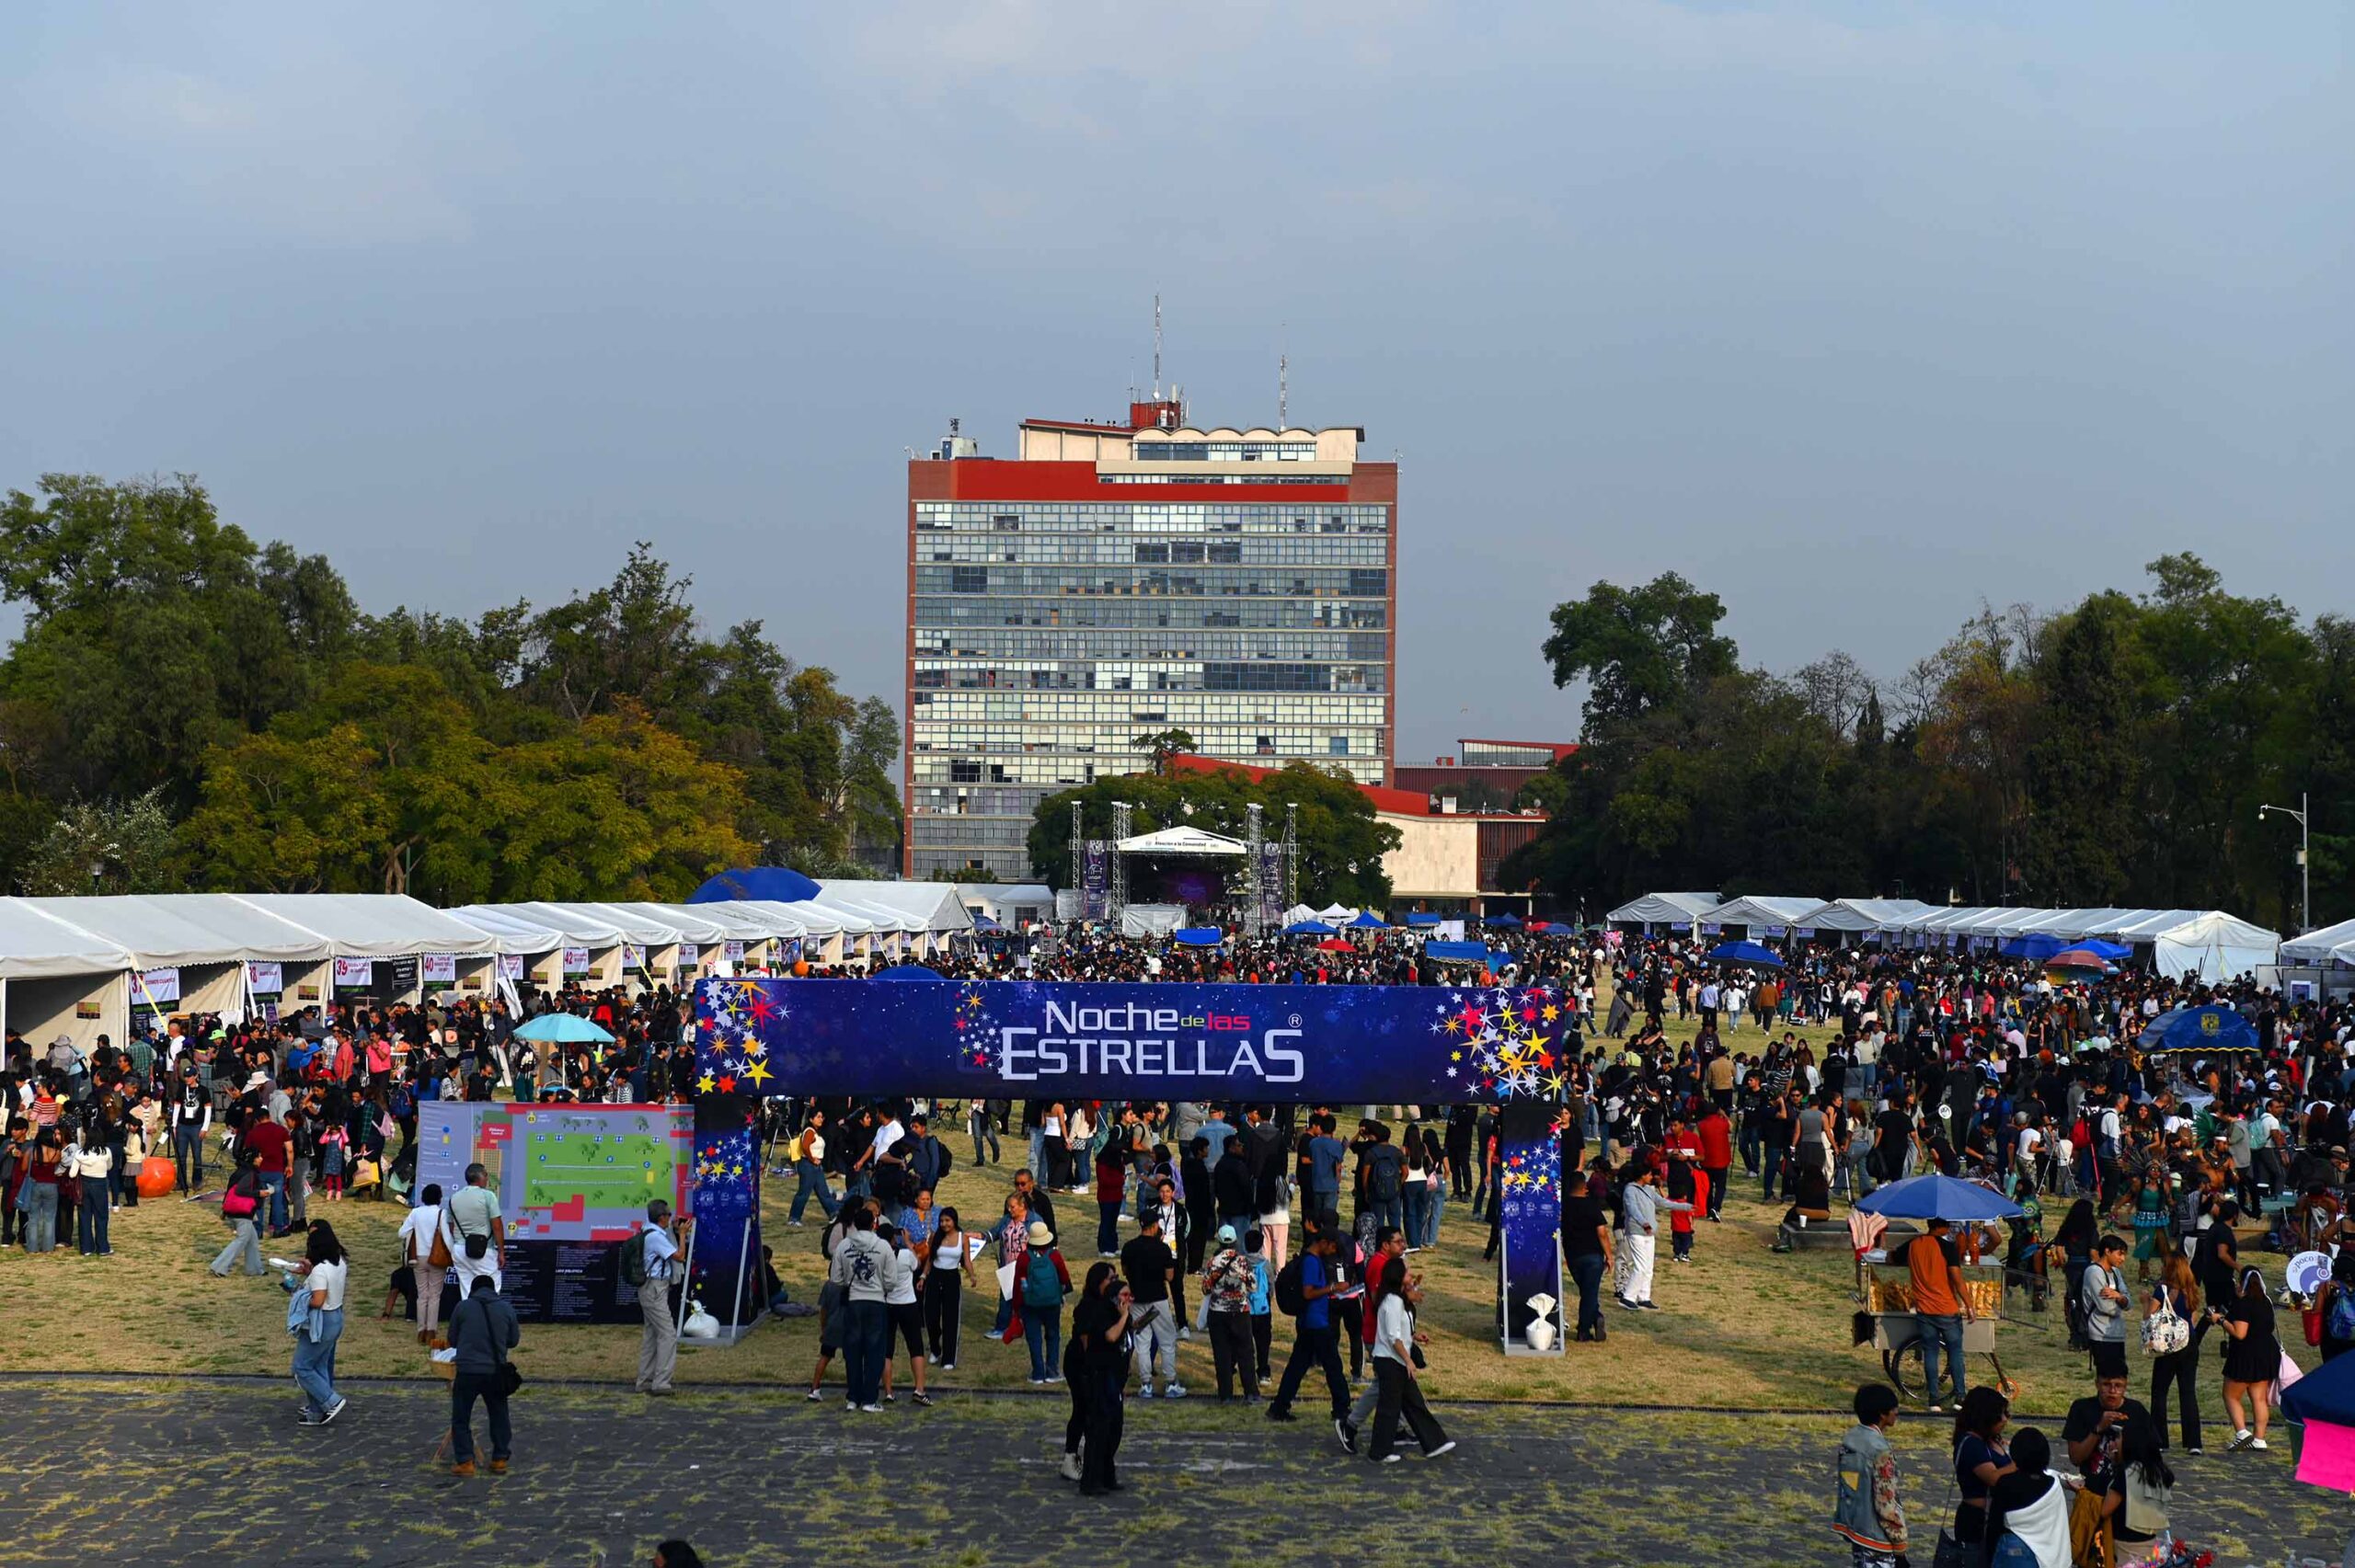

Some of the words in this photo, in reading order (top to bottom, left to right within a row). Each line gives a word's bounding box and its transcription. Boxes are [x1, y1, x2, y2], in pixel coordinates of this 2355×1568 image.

[424, 956, 434, 972] 40
[565, 951, 573, 965] 42
[337, 959, 348, 976] 39
[1046, 1001, 1178, 1034] Noche
[1180, 1015, 1205, 1027] de
[1207, 1012, 1251, 1031] las
[1002, 1027, 1304, 1083] ESTRELLAS
